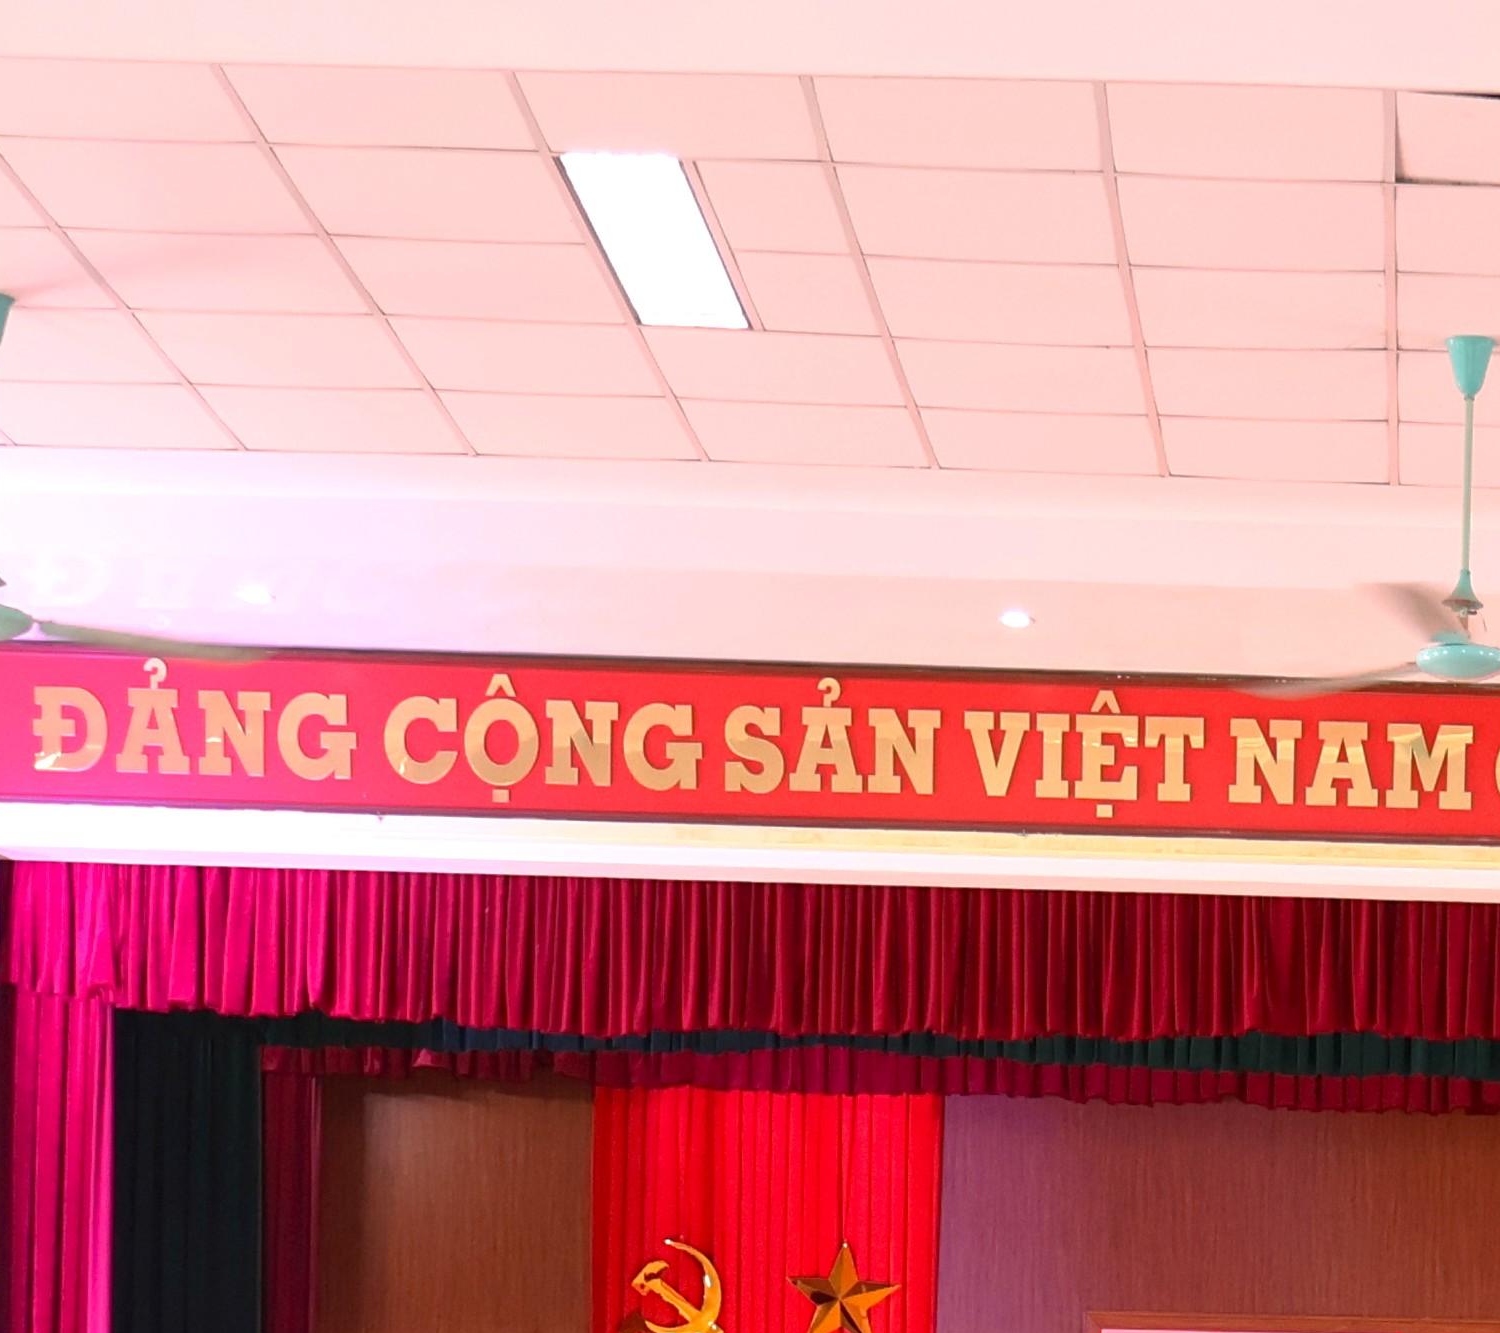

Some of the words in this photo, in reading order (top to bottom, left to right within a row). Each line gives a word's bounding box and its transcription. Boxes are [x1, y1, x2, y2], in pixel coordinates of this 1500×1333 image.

[33, 657, 356, 780] ĐẢNG
[384, 674, 702, 802] CỘNG
[725, 678, 940, 794] SẢN
[964, 690, 1204, 817] VIỆT
[1229, 719, 1473, 810] NAM
